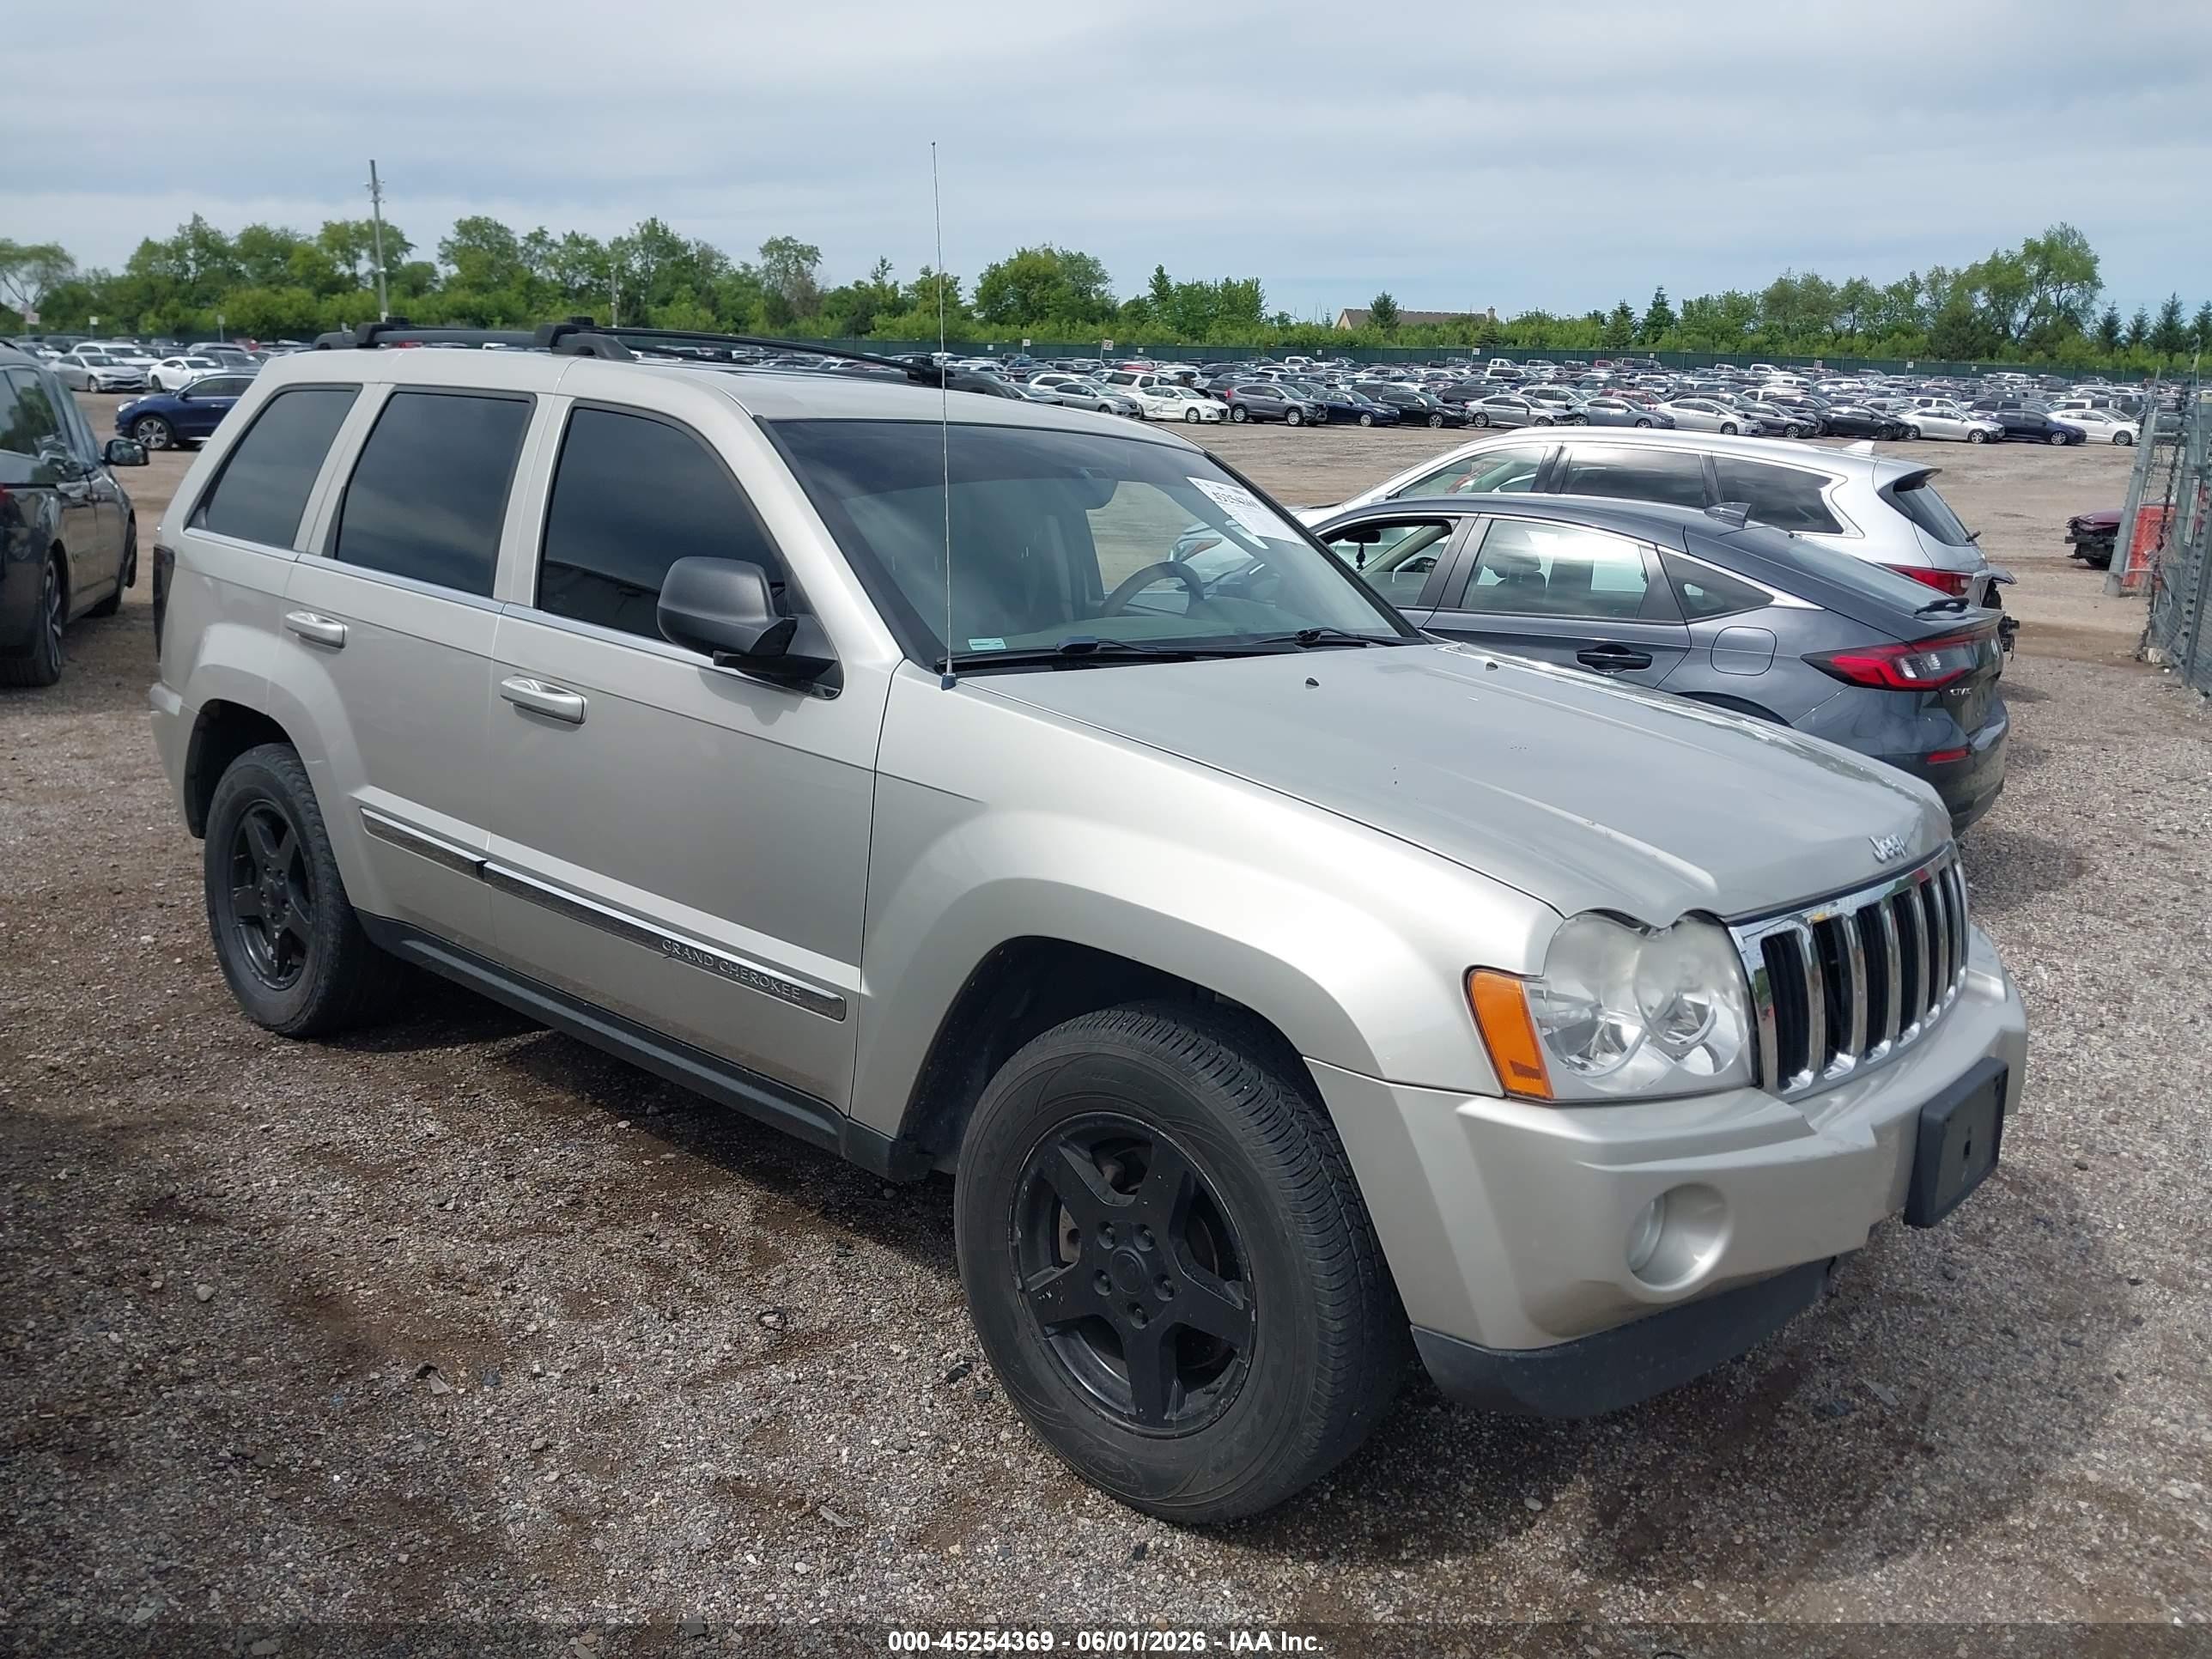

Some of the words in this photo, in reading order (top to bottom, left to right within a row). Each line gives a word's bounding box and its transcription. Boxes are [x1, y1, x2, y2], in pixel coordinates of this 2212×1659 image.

[1868, 836, 1906, 864] Jeep
[662, 939, 714, 968] GRAND
[719, 961, 802, 1000] CHEROKEE
